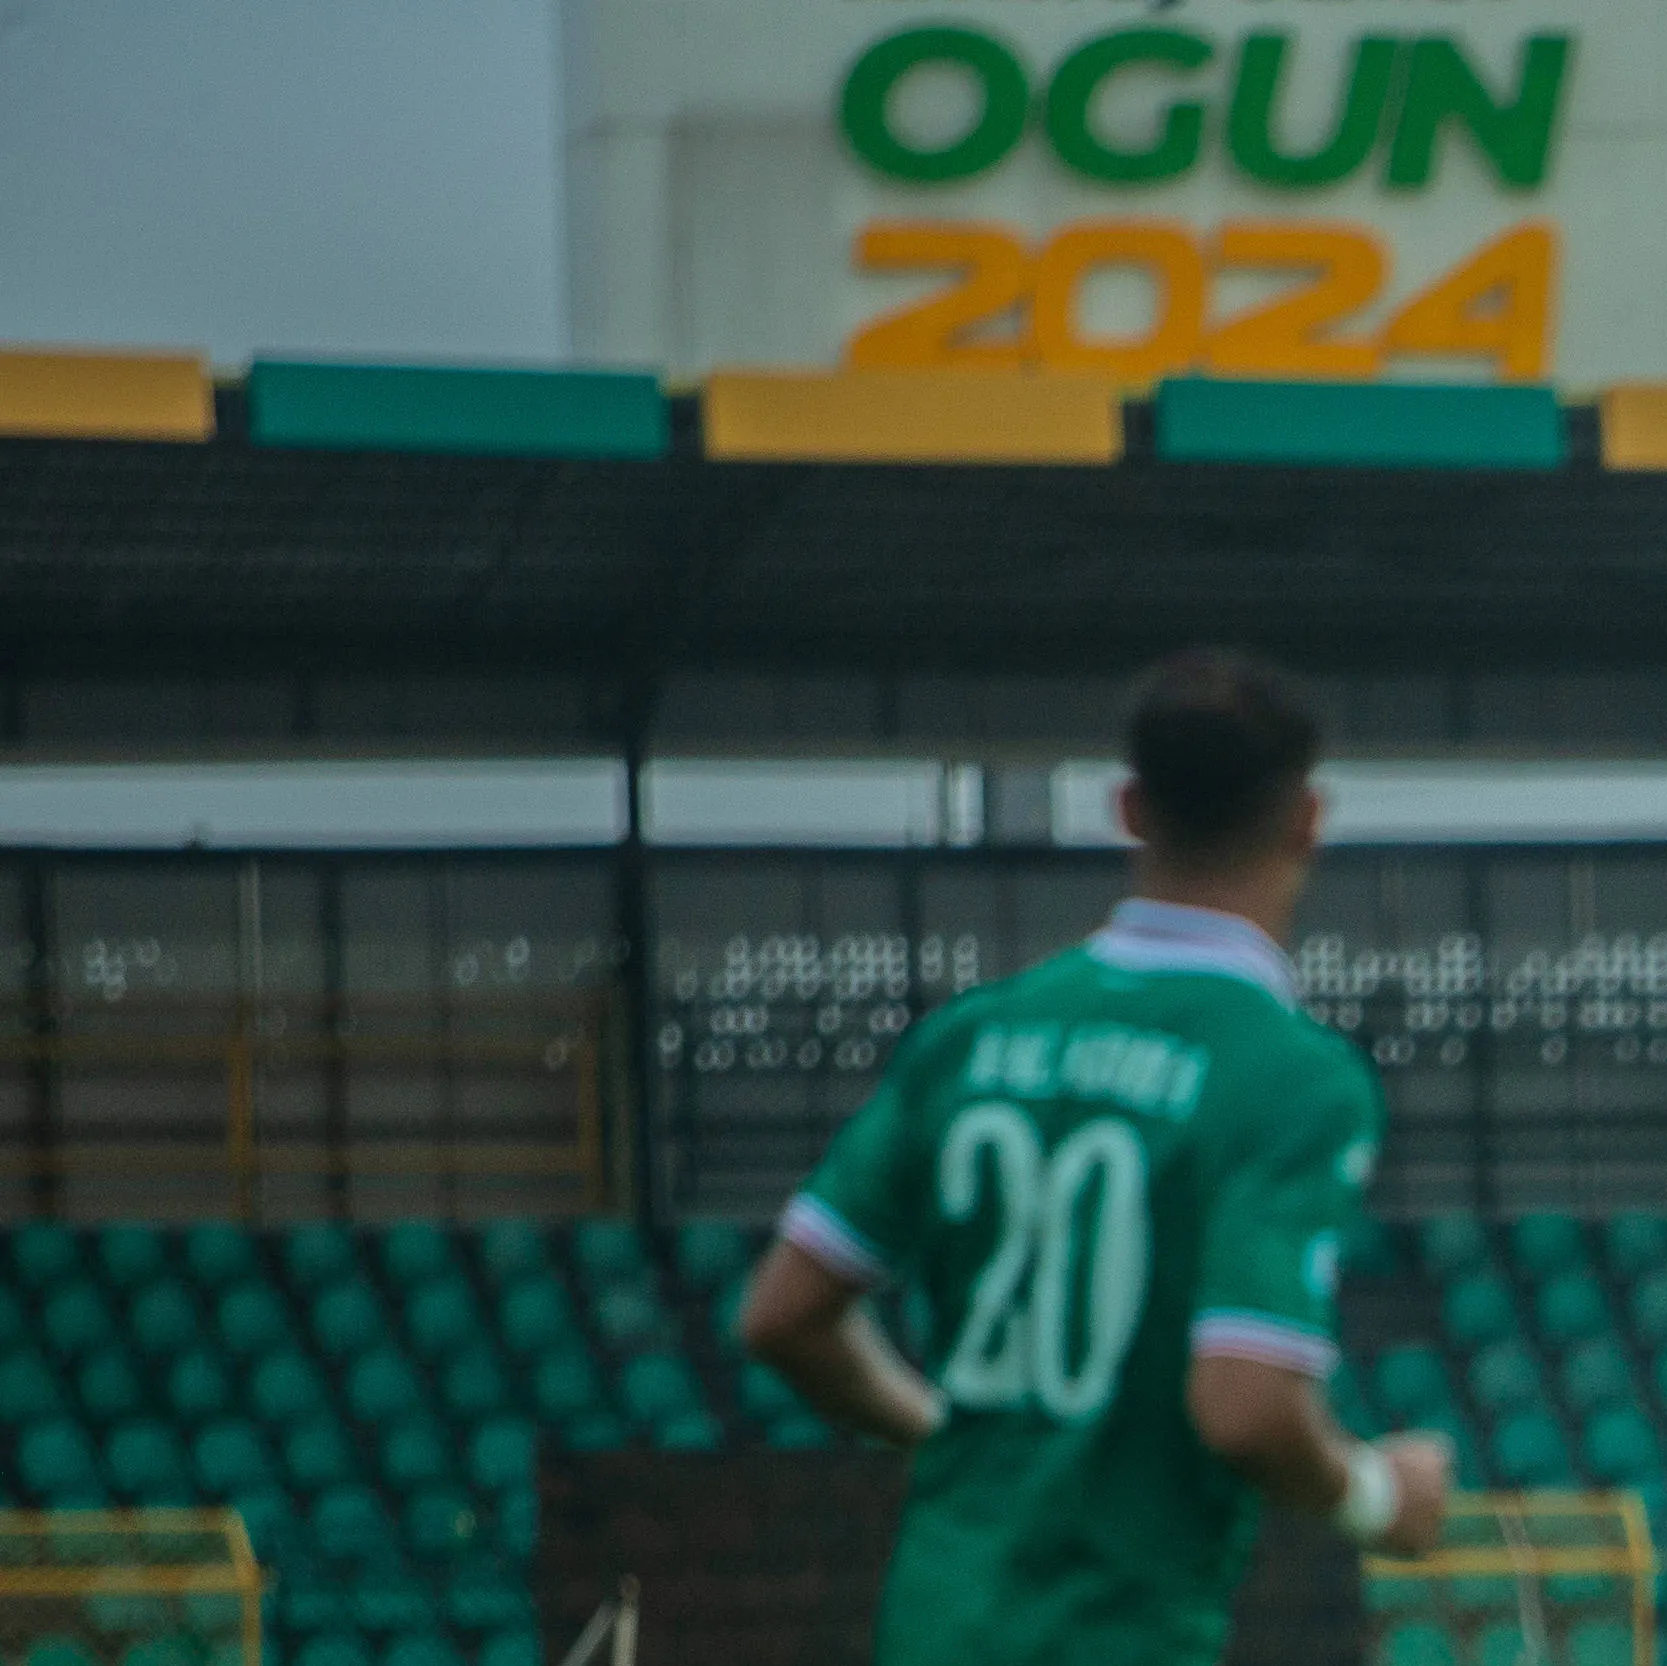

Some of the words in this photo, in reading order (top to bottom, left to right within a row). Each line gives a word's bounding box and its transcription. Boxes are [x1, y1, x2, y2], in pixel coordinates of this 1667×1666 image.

[840, 26, 1572, 193] OGUN
[848, 222, 1558, 382] 2024
[940, 1100, 1150, 1422] 20
